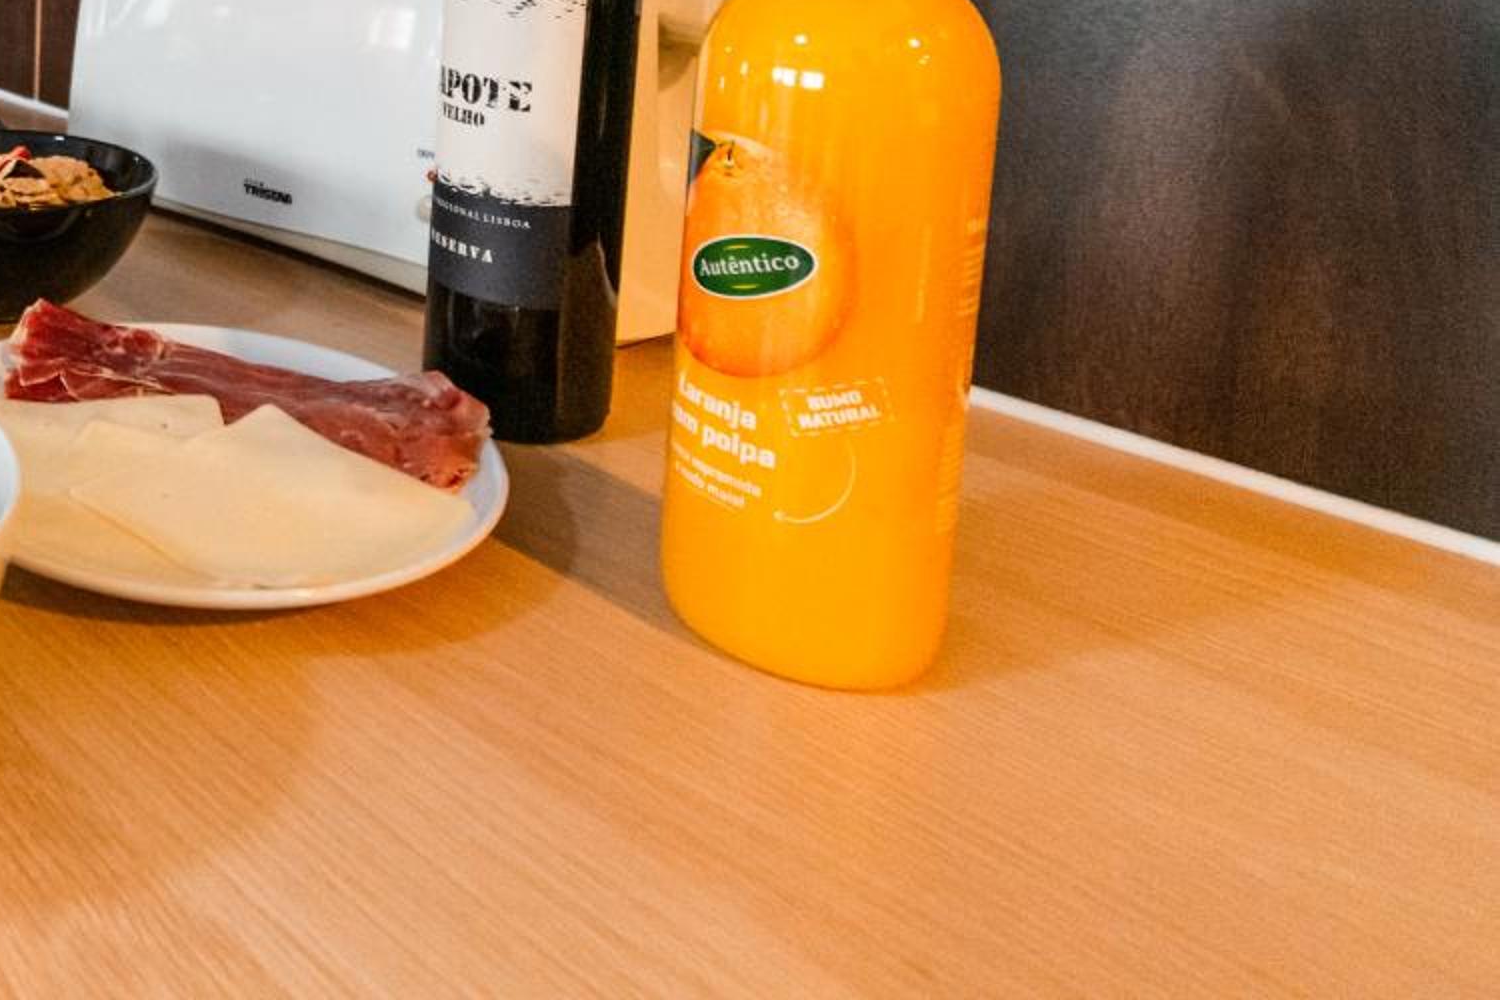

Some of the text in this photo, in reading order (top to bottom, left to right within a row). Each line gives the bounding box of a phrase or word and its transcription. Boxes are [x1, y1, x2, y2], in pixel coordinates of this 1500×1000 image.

[483, 214, 532, 230] LISBOA
[700, 252, 801, 277] Autêntico
[798, 404, 882, 430] NATURAL
[702, 425, 777, 472] polpa
